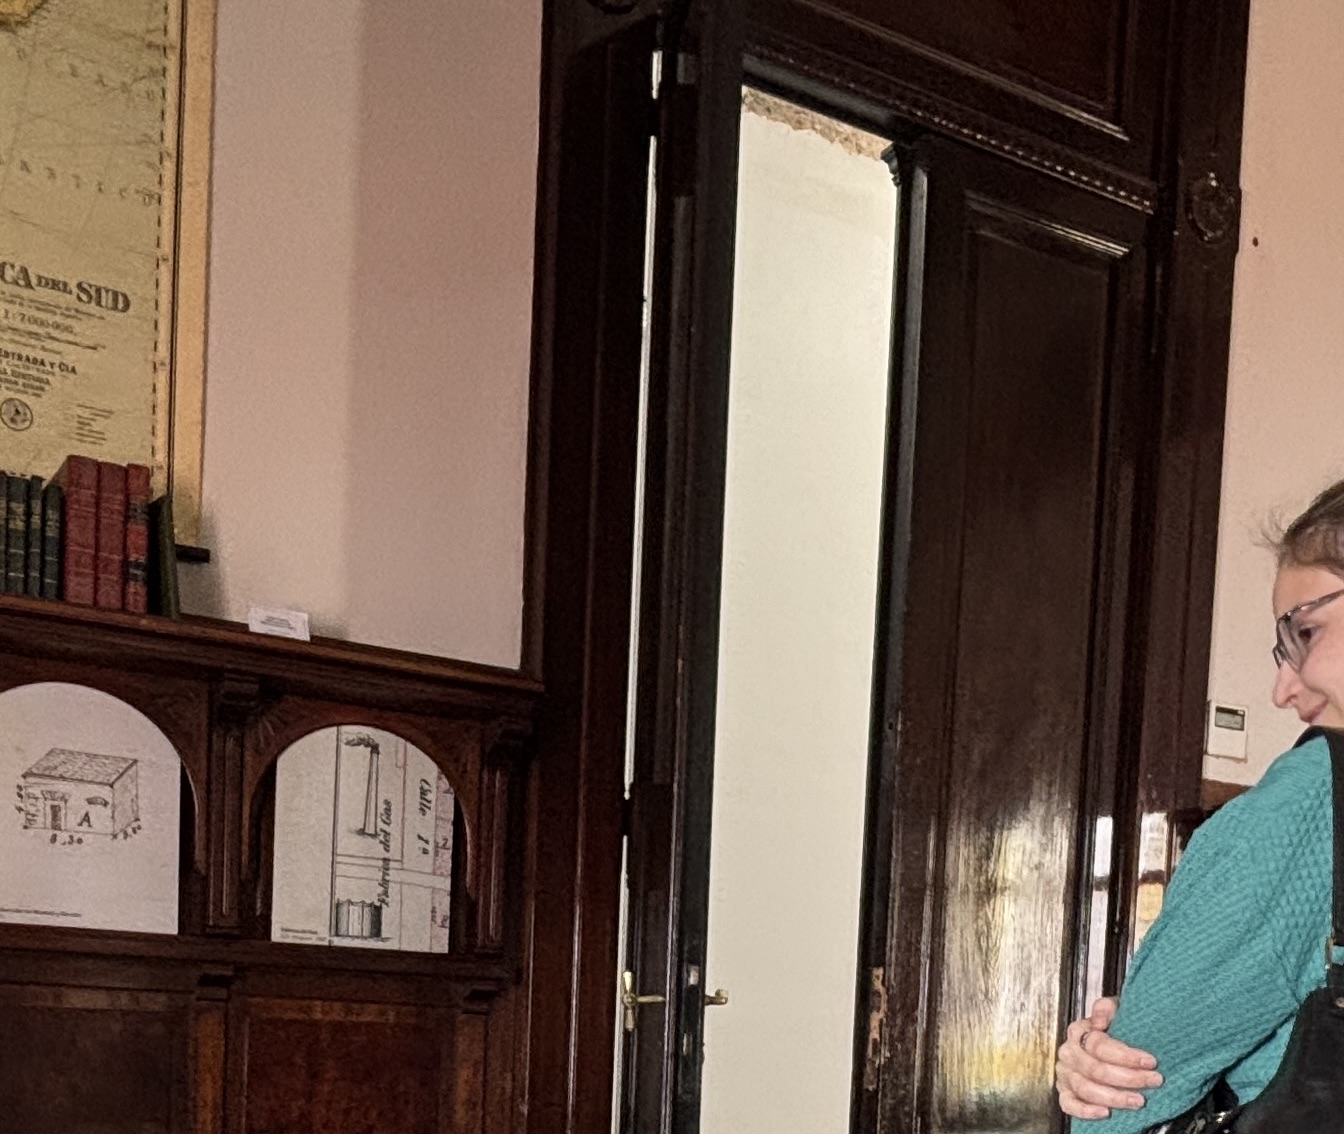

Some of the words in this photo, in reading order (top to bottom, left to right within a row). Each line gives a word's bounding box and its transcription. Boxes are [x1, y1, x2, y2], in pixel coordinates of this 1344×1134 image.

[35, 274, 73, 295] DEL
[75, 280, 131, 313] SUD
[418, 778, 432, 816] Calle
[77, 810, 93, 828] A
